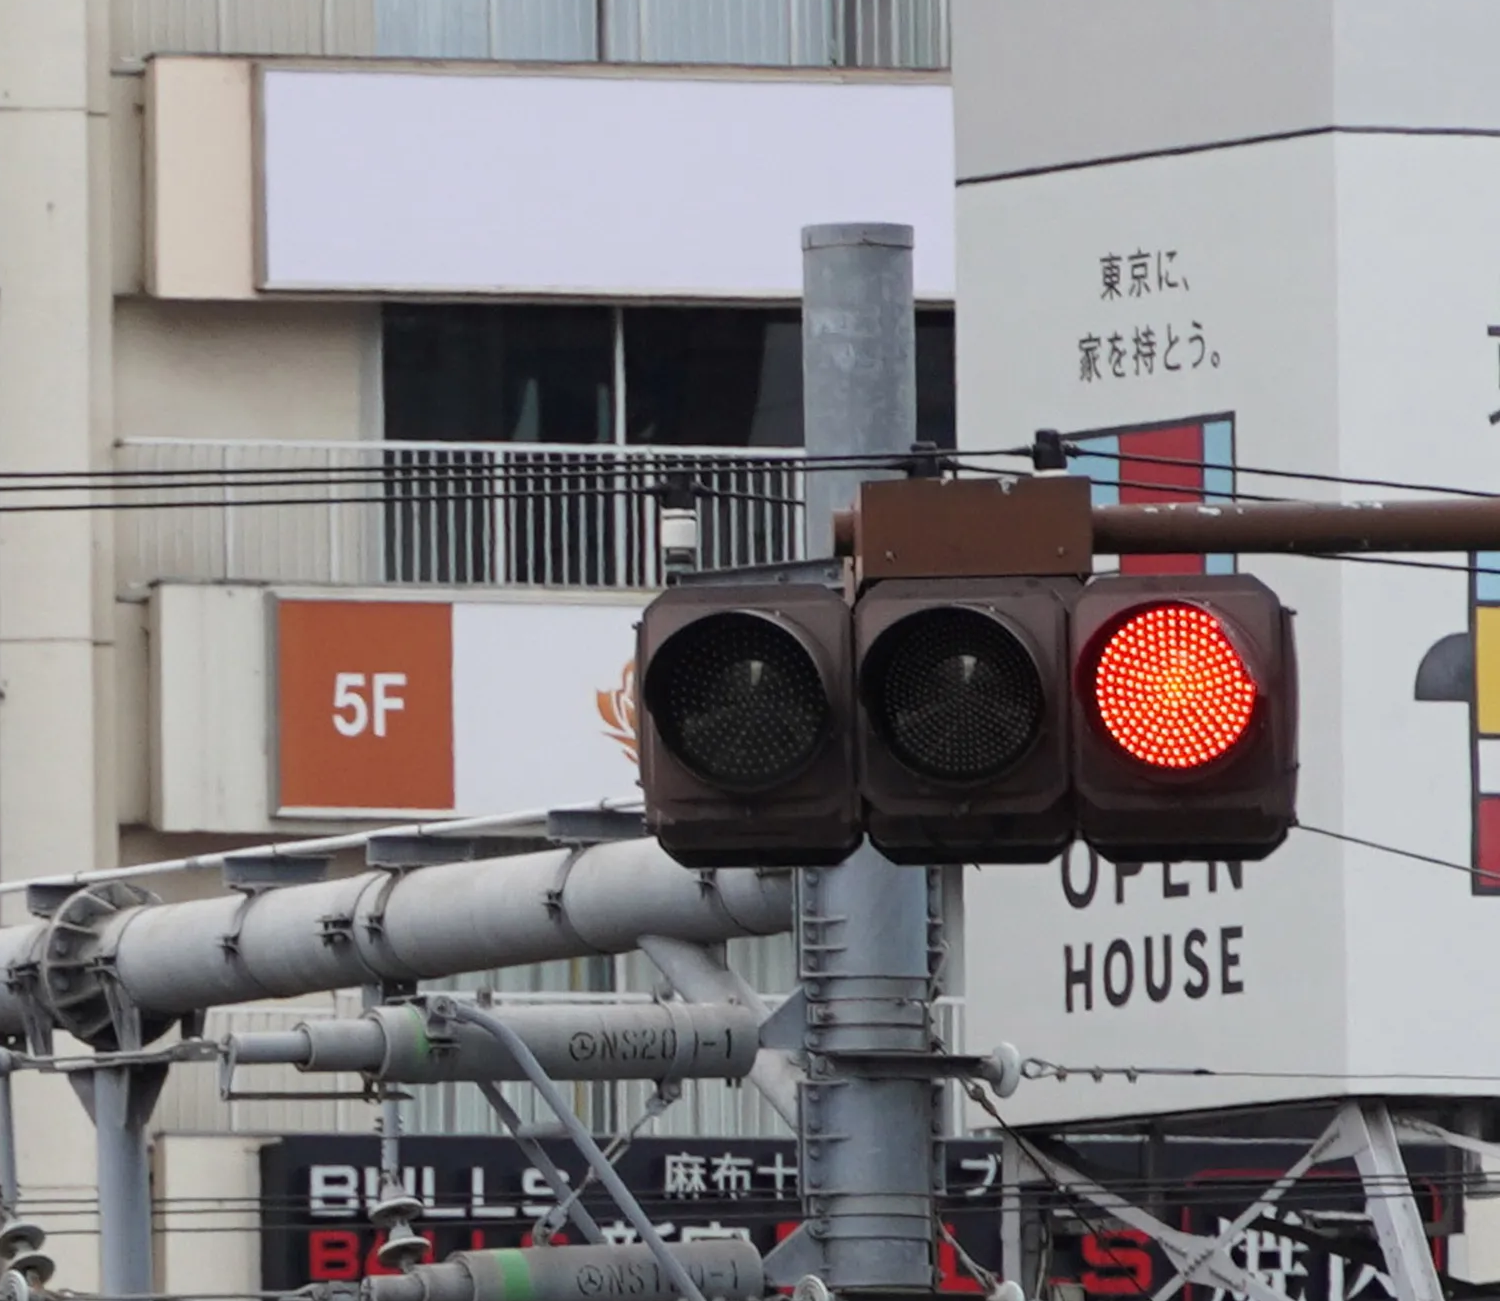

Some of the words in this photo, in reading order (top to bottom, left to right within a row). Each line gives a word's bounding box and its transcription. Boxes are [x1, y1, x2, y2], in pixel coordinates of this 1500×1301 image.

[1098, 249, 1190, 300] 東京に、
[1077, 320, 1222, 383] 家を持とう。
[332, 672, 408, 738] 5F
[1063, 926, 1246, 1014] HOUSE
